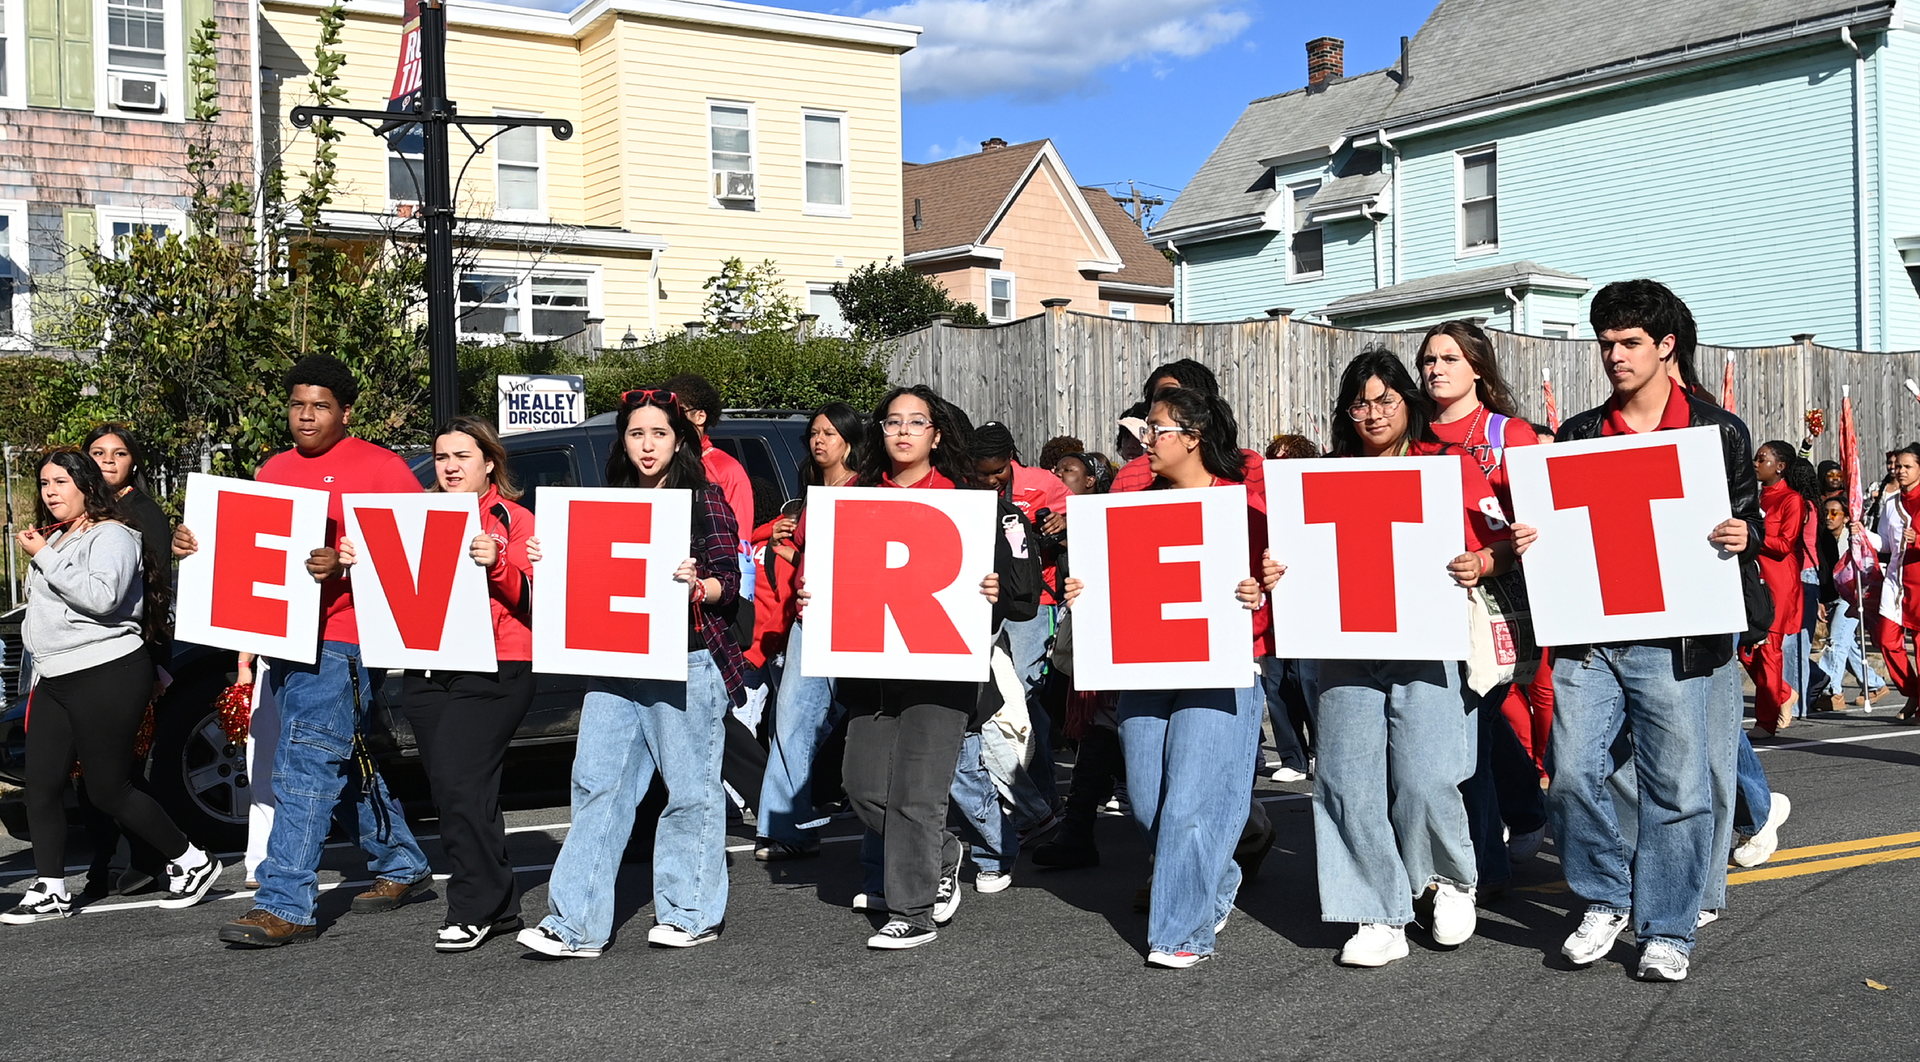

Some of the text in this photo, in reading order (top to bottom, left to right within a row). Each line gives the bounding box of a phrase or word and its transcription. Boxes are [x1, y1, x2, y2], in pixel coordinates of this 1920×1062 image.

[508, 381, 534, 392] Vote
[508, 393, 576, 410] HEALEY
[508, 411, 578, 425] DRISCOLL
[211, 491, 293, 637] E
[354, 508, 468, 651] V
[566, 501, 652, 654] E
[831, 500, 972, 654] R
[1106, 502, 1209, 664] E
[1302, 470, 1423, 632] T
[1546, 444, 1684, 615] T
